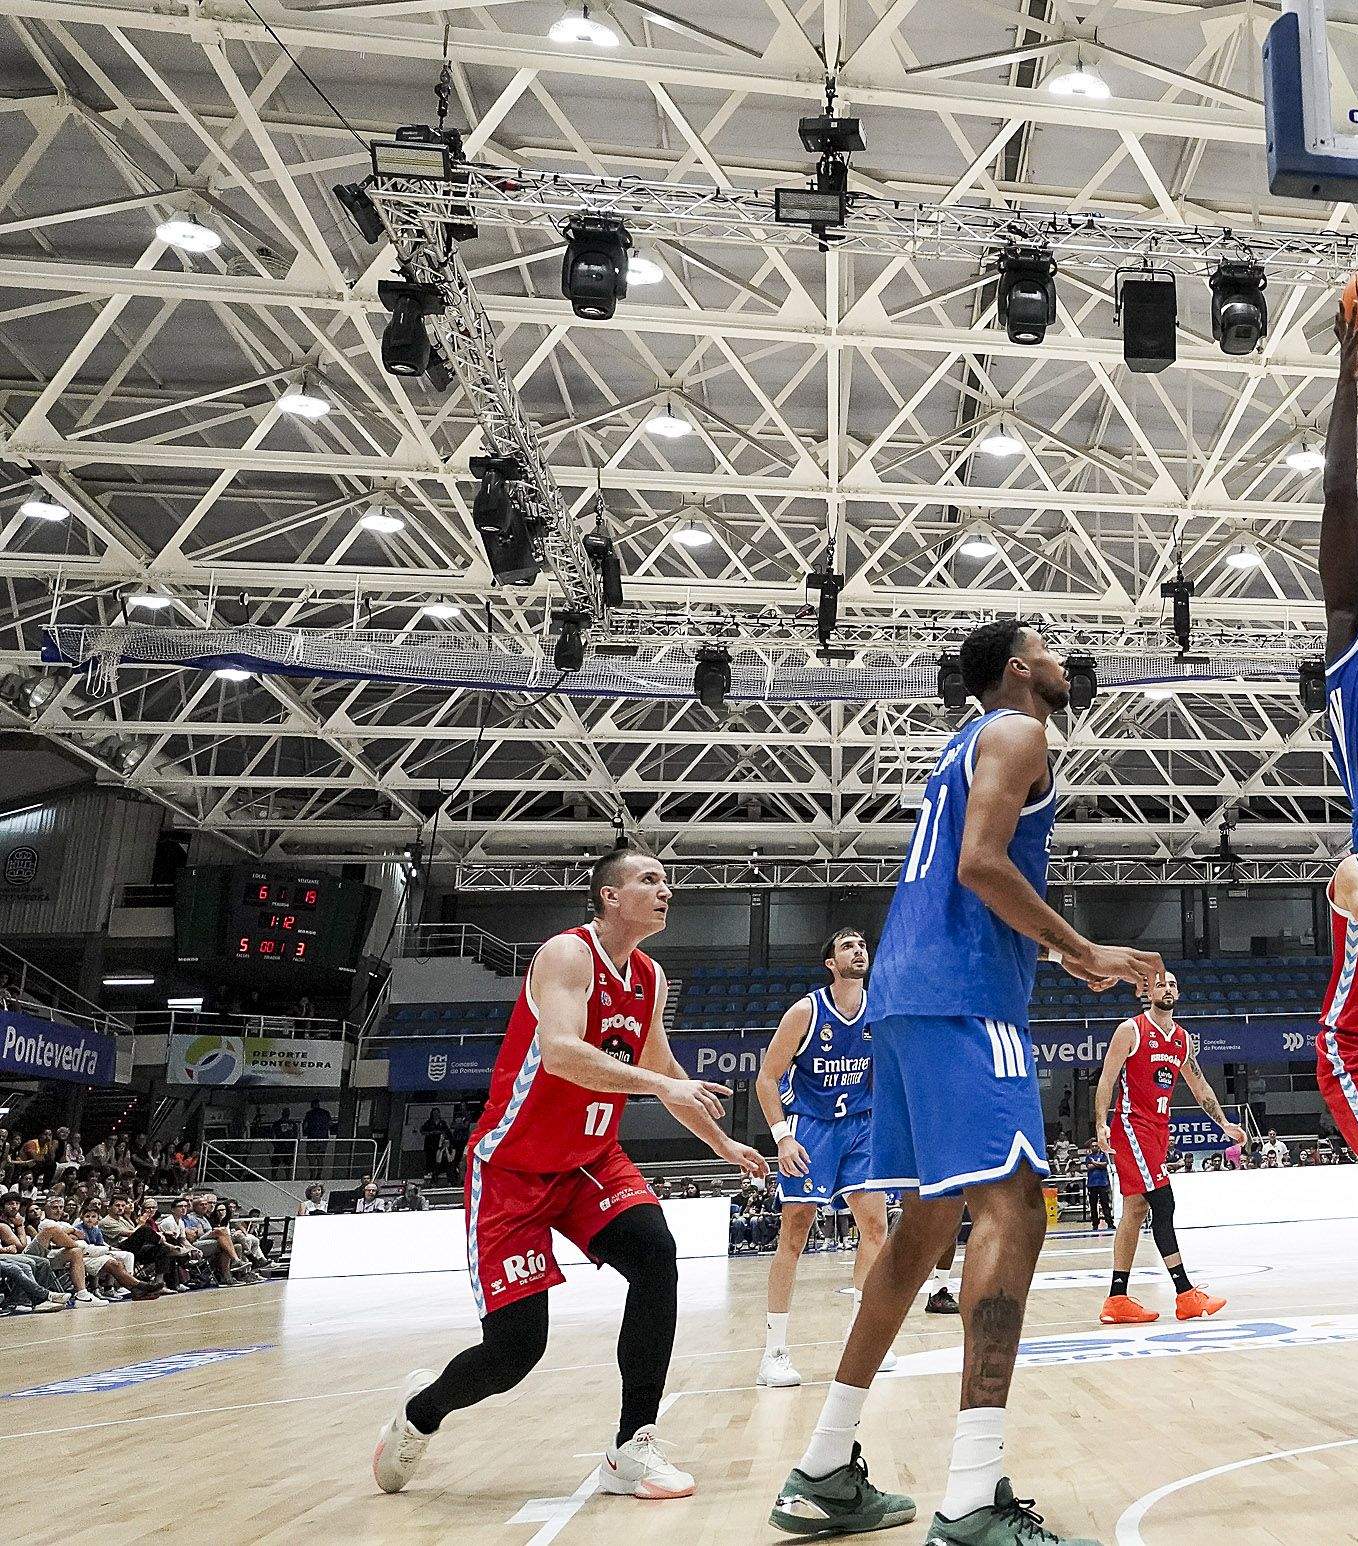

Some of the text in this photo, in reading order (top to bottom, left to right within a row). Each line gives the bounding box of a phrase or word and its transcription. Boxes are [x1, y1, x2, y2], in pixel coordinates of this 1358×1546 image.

[259, 885, 269, 899] 6
[270, 915, 295, 930] 1:12
[239, 938, 249, 952] 5
[296, 942, 305, 956] 3
[2, 1025, 99, 1075] Pontevedra
[252, 1050, 308, 1059] DEPORTE
[251, 1060, 331, 1069] PONTEVEDRA
[812, 1056, 870, 1074] Emirate
[823, 1072, 838, 1087] FLY
[834, 1093, 849, 1118] 5
[584, 1101, 614, 1137] 17
[502, 1250, 546, 1284] Río
[519, 1278, 529, 1286] DE
